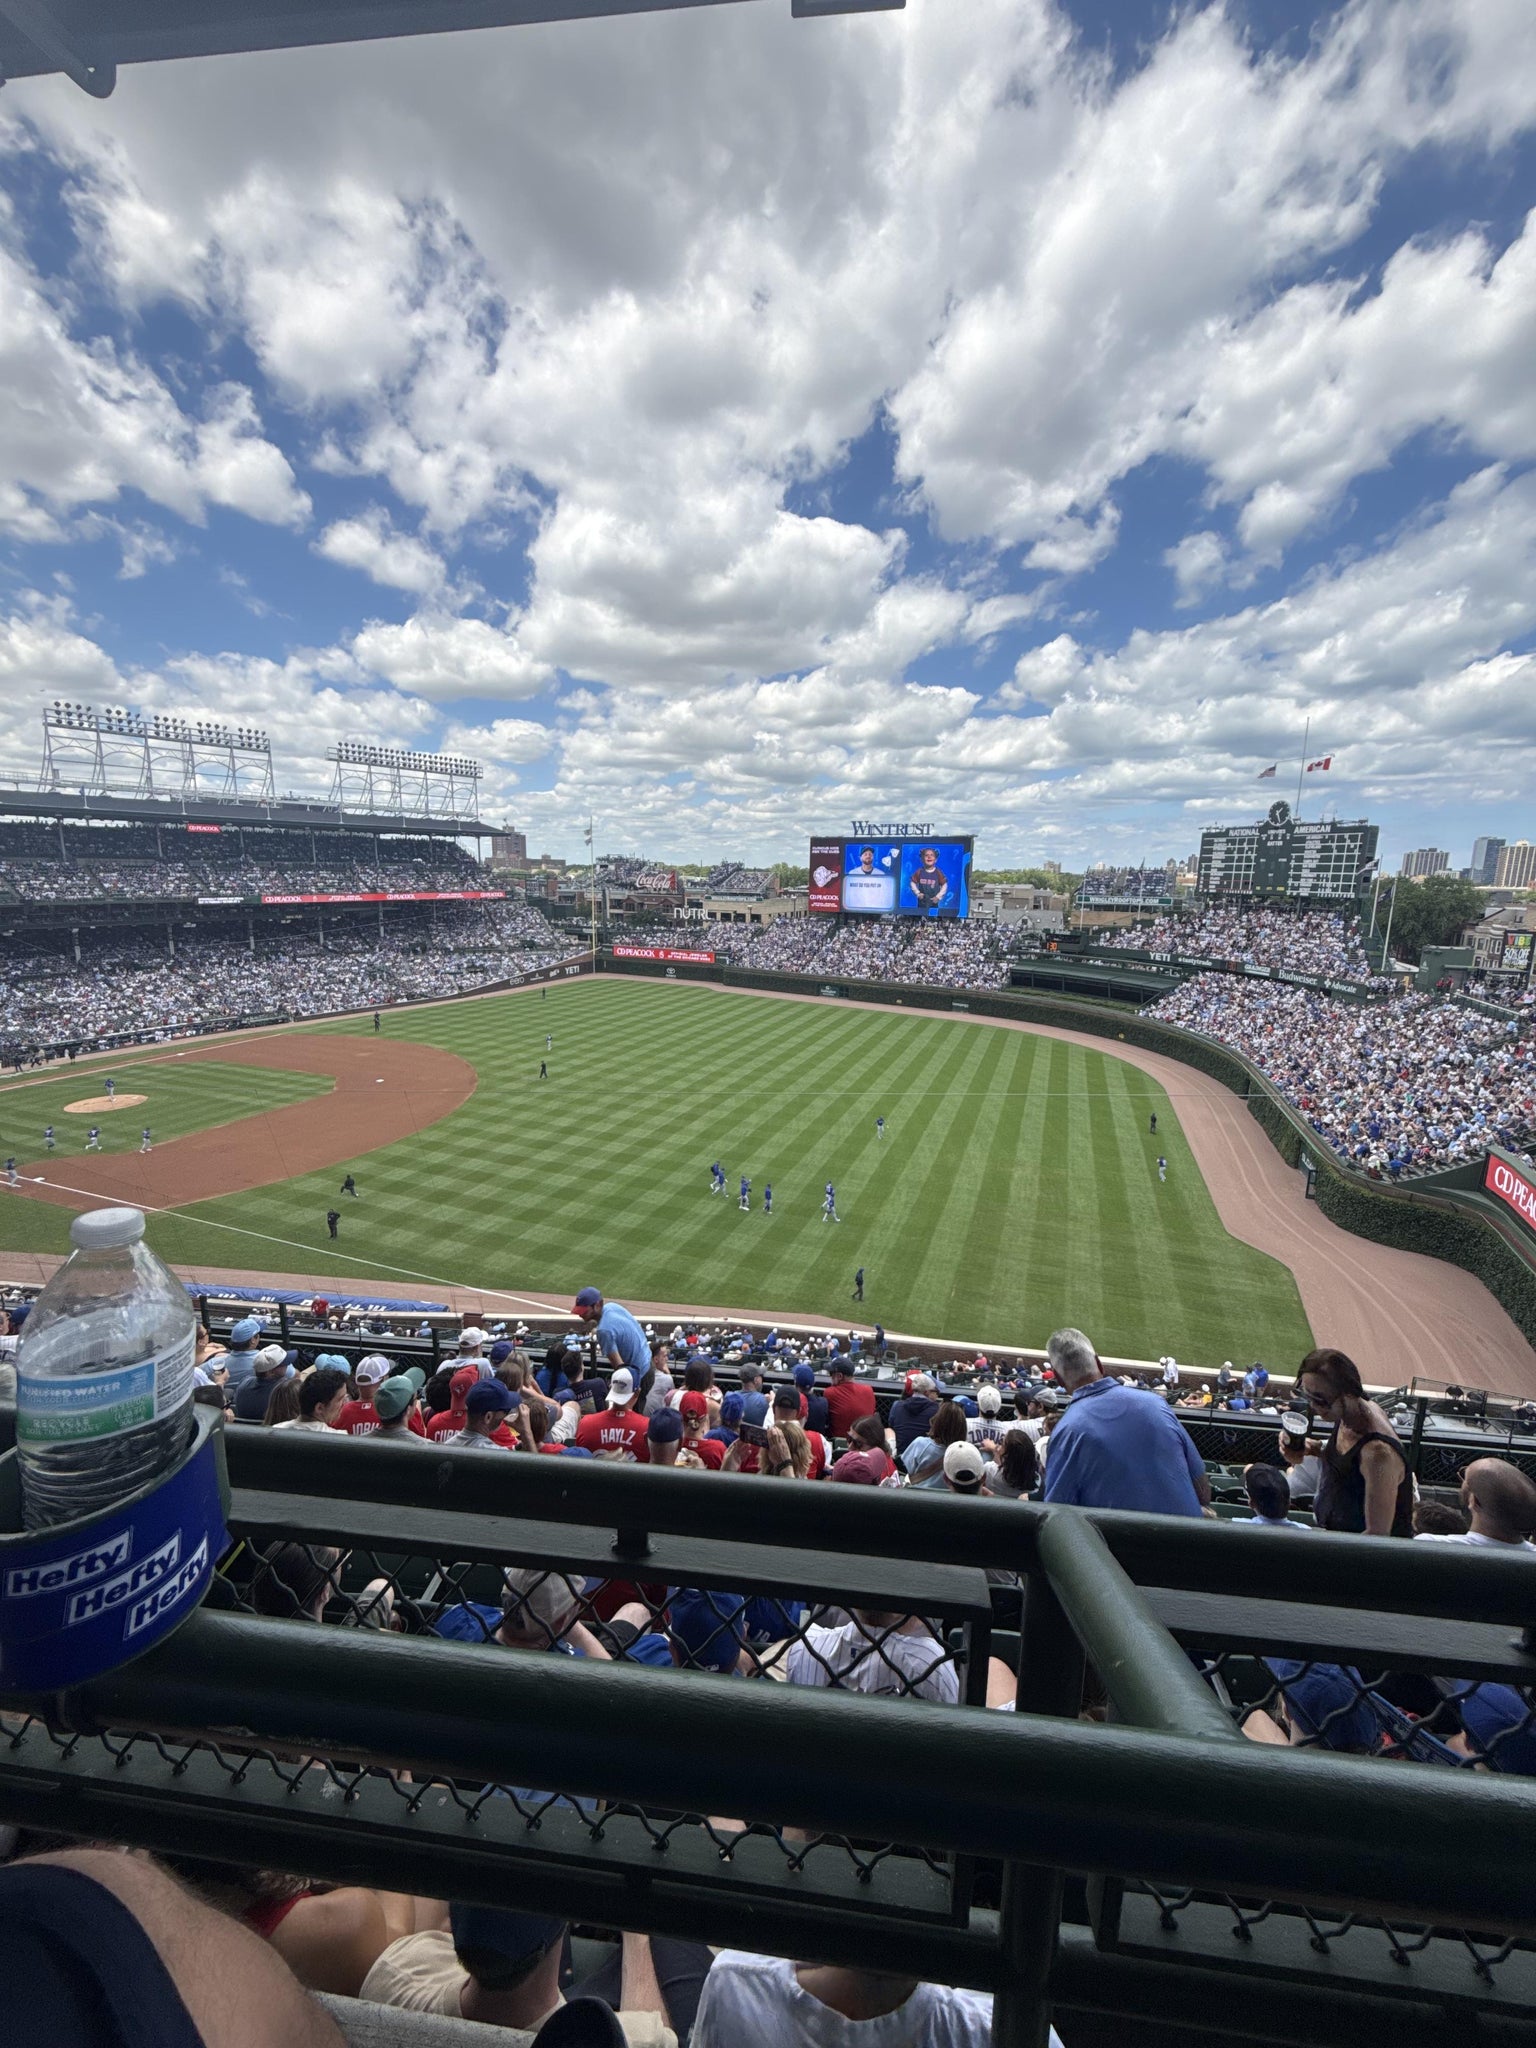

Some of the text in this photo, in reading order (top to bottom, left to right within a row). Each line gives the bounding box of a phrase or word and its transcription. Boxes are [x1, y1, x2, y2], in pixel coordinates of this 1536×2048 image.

[851, 820, 935, 836] WINTRUST
[1228, 828, 1260, 836] NATIONAL
[1293, 825, 1331, 834] AMERICAN
[626, 949, 655, 957] PEACOCK
[1150, 952, 1171, 961] YETI
[565, 965, 580, 975] YETI
[1279, 969, 1318, 985] Budweiser
[1331, 982, 1357, 994] Advocate
[1494, 1165, 1514, 1194] CD
[74, 1382, 121, 1396] WATER
[33, 1416, 89, 1429] RECYCLE
[600, 1428, 636, 1445] HAYLZ
[13, 1542, 125, 1593] Hefty
[74, 1546, 176, 1618] Hefty
[134, 1549, 206, 1627] Hefty
